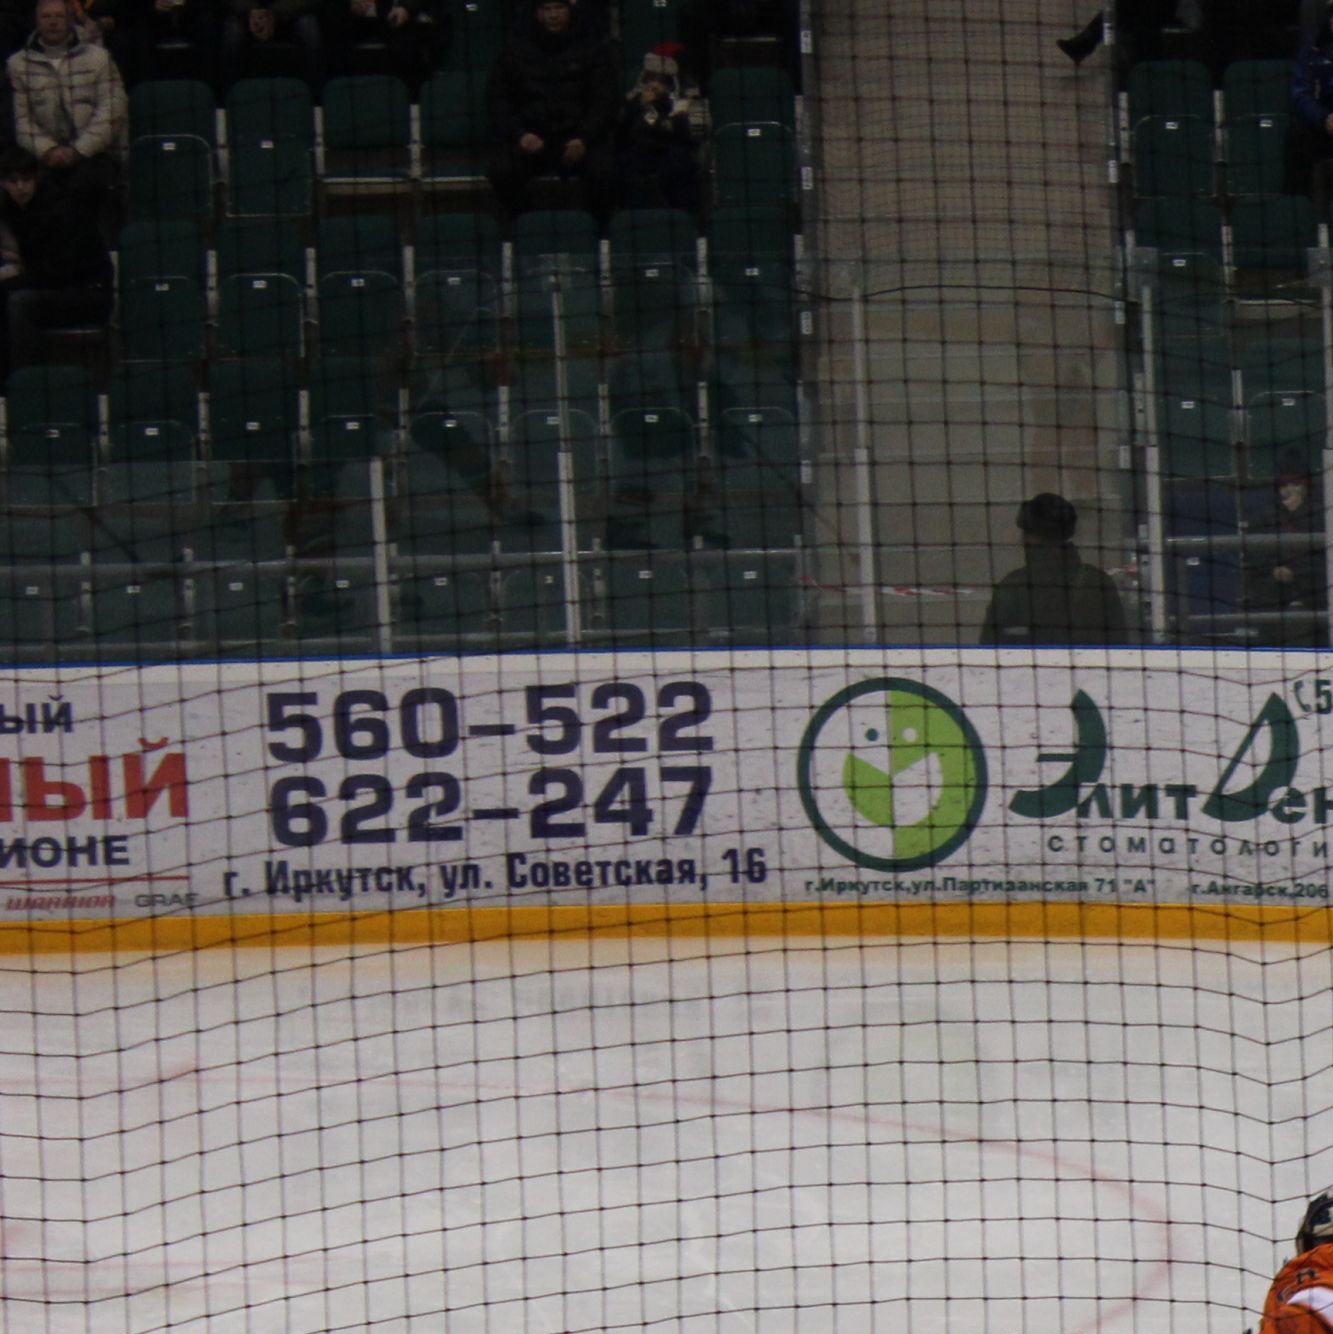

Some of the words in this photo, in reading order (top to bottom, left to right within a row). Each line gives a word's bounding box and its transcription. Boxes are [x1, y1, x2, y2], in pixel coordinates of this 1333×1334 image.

[267, 681, 713, 763] 560-522
[270, 765, 712, 846] 622-247
[134, 893, 199, 907] GRAF
[223, 870, 250, 897] г.
[265, 860, 426, 900] Иркутск,
[440, 866, 493, 898] ул.
[507, 851, 709, 891] Советская,
[722, 847, 767, 884] 16
